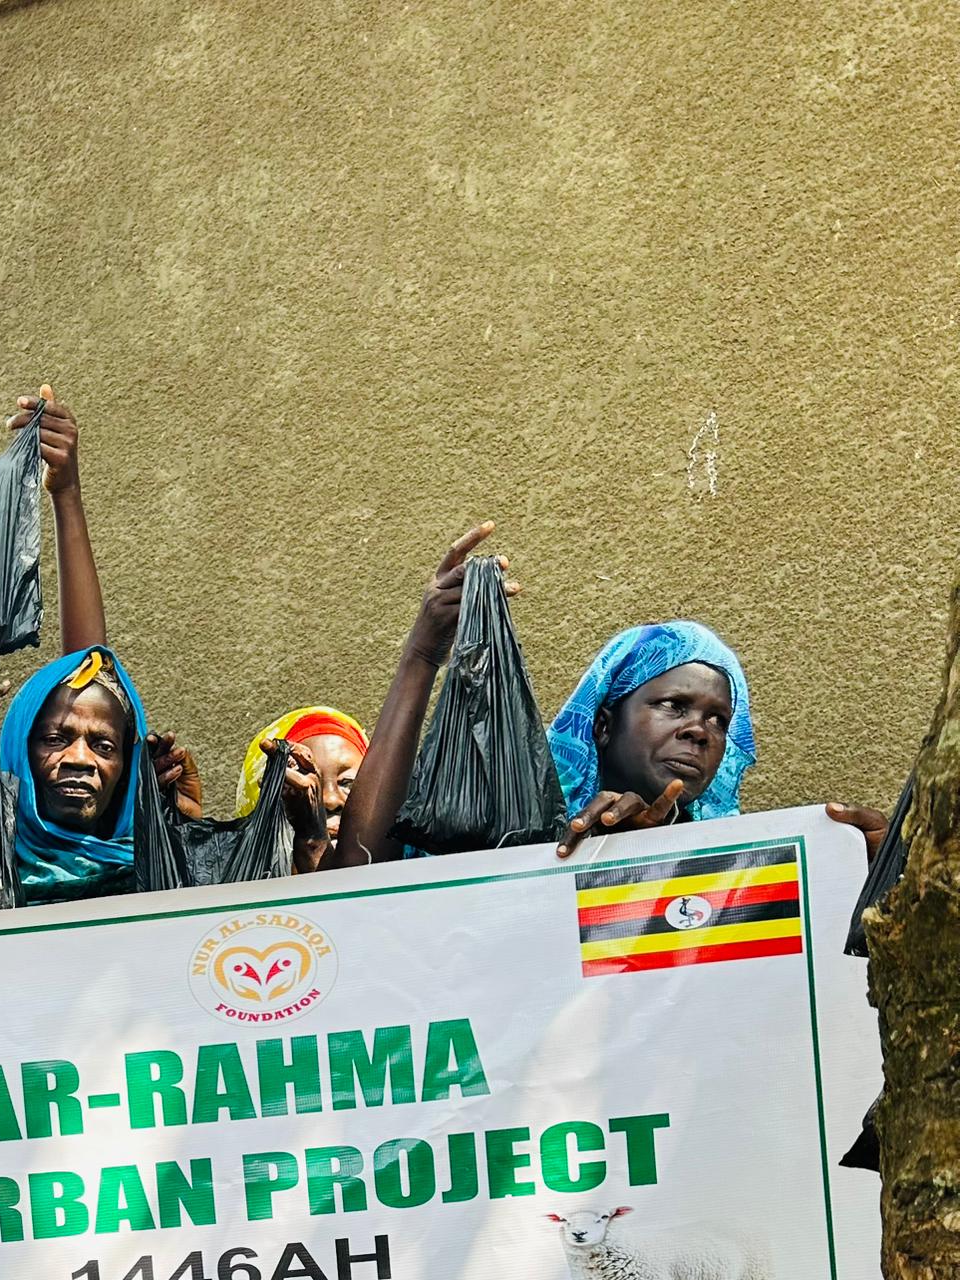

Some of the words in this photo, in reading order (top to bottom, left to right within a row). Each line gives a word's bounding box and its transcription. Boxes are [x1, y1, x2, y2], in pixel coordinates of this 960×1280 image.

[192, 938, 220, 976] NUR
[218, 914, 331, 958] AL-SADAQA
[215, 988, 321, 1022] FOUNDATION
[242, 1112, 671, 1222] PROJECT
